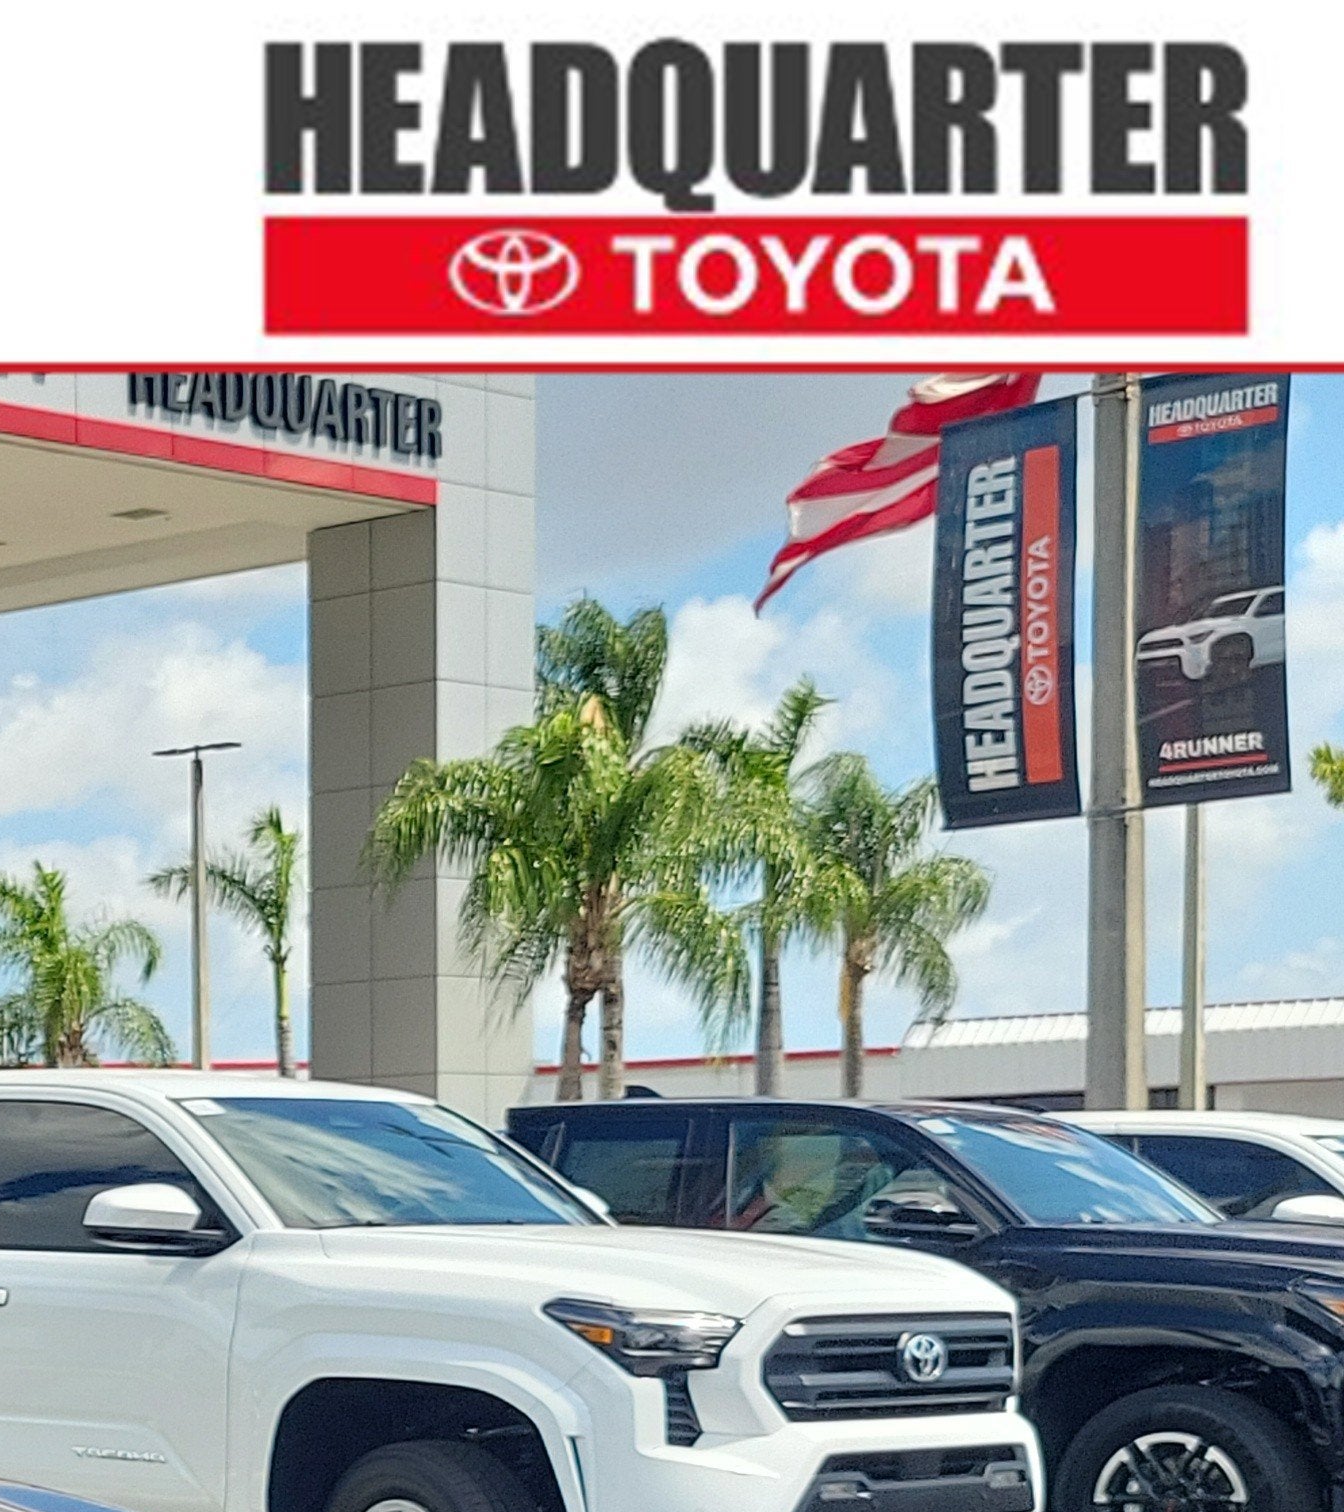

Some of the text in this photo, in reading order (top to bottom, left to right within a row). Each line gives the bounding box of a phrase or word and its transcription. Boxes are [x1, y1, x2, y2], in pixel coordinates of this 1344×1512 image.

[1148, 381, 1278, 428] HEADQUARTER
[962, 455, 1020, 793] HEADQUARTER
[1026, 534, 1052, 664] TOYOTA
[1159, 731, 1264, 760] 4RUNNER
